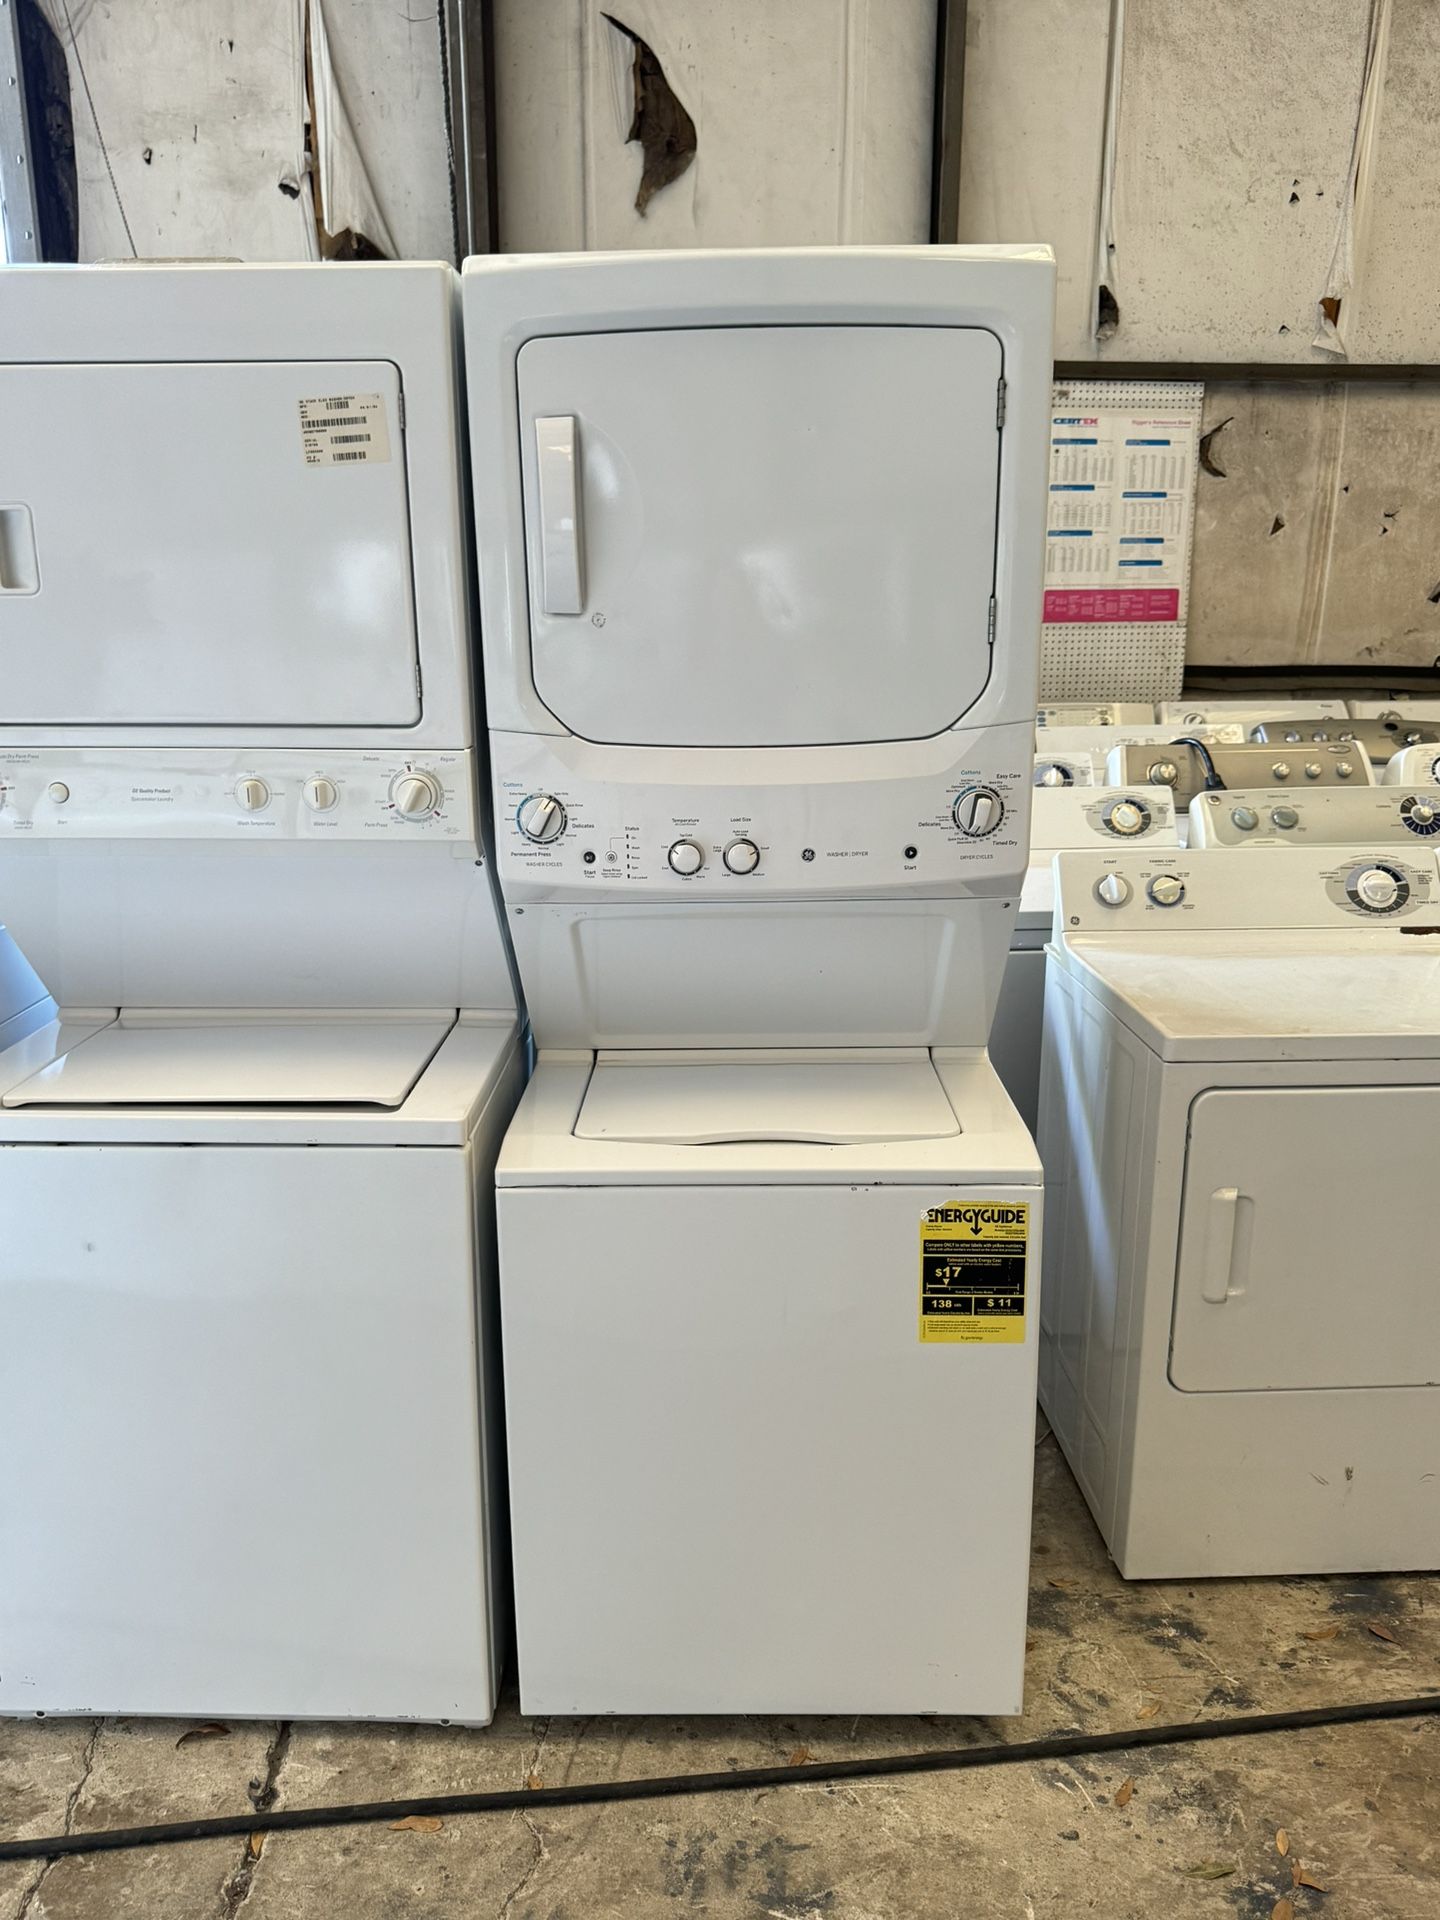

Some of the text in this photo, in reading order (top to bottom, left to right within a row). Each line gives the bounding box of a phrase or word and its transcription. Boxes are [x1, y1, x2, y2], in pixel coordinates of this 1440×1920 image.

[927, 1209, 1025, 1224] ENERGYGUIDE
[935, 1267, 961, 1277] $17
[932, 1300, 952, 1308] 138
[998, 1299, 1011, 1307] 11
